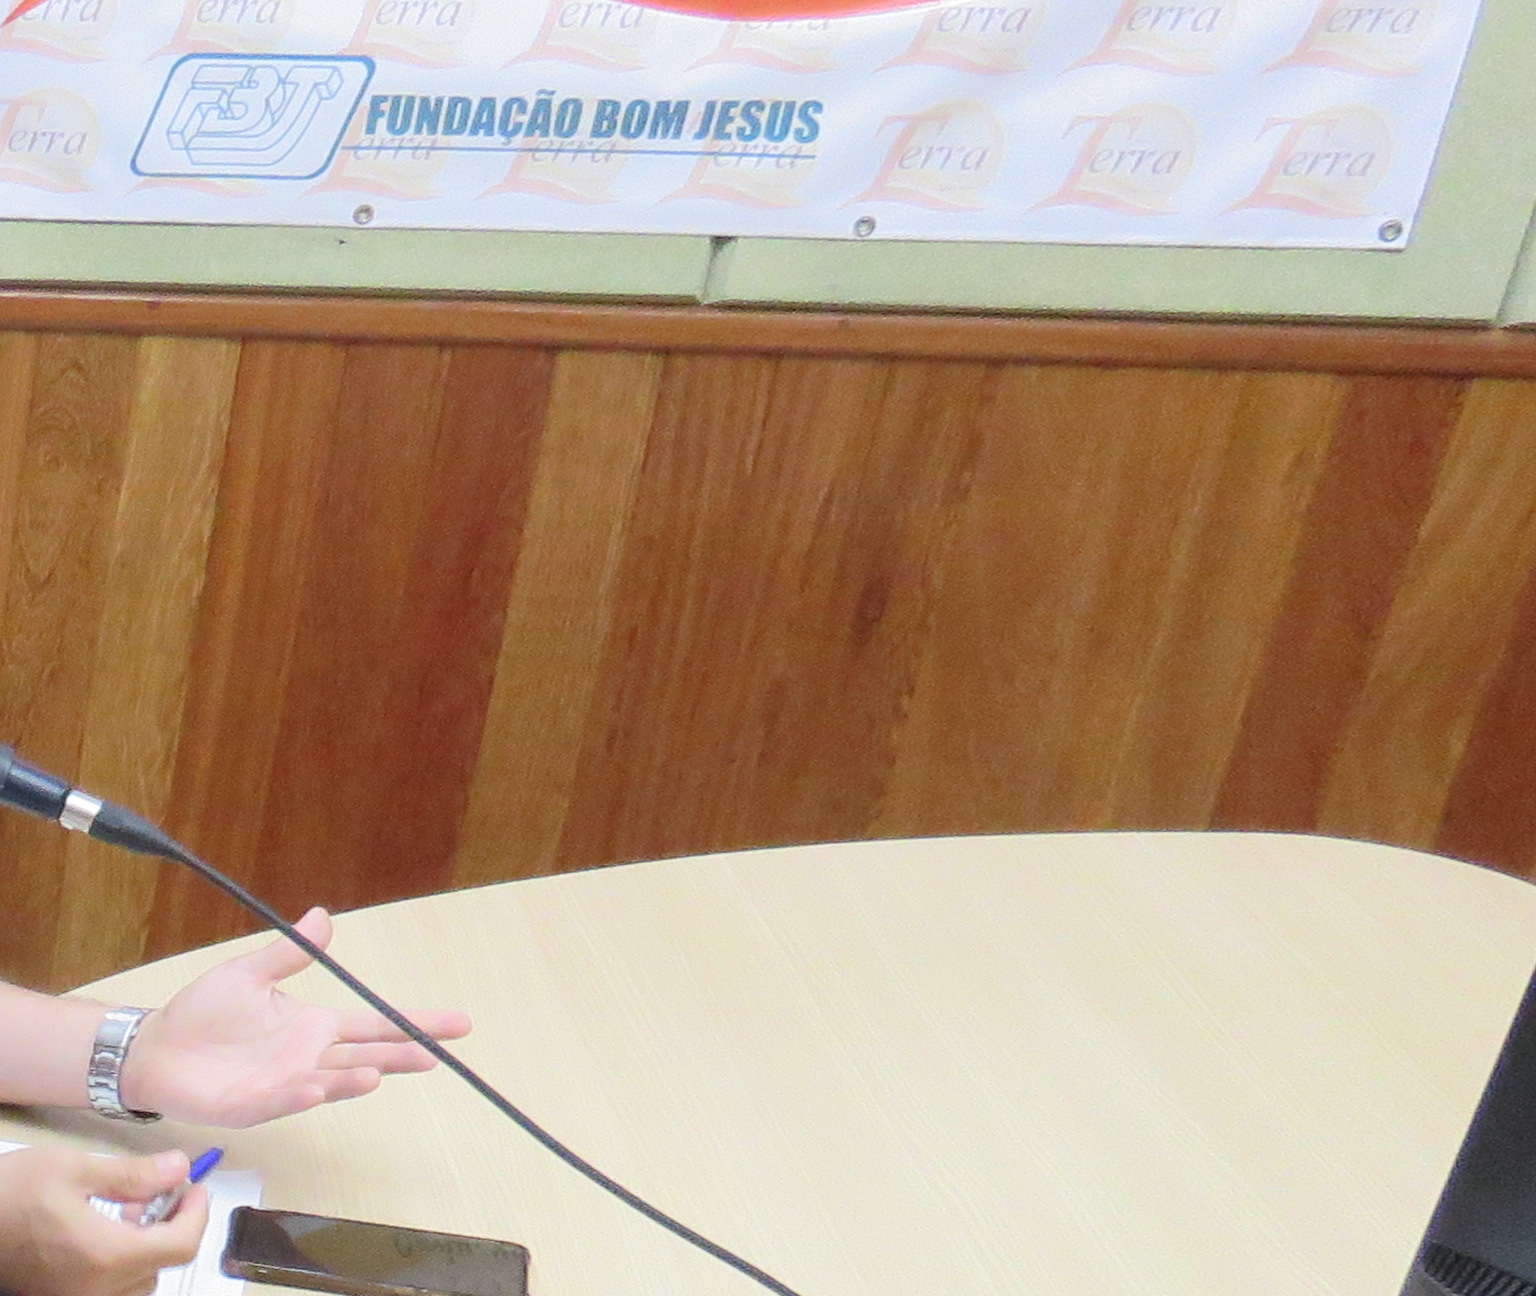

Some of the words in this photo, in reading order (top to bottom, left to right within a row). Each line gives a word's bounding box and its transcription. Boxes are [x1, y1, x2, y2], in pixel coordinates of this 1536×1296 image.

[365, 88, 583, 146] FUNDAÇÃO
[590, 99, 691, 141] BOM
[693, 100, 823, 144] JESUS
[837, 113, 990, 212] Terra
[1027, 115, 1184, 217] Terra
[1214, 117, 1376, 219] Terra
